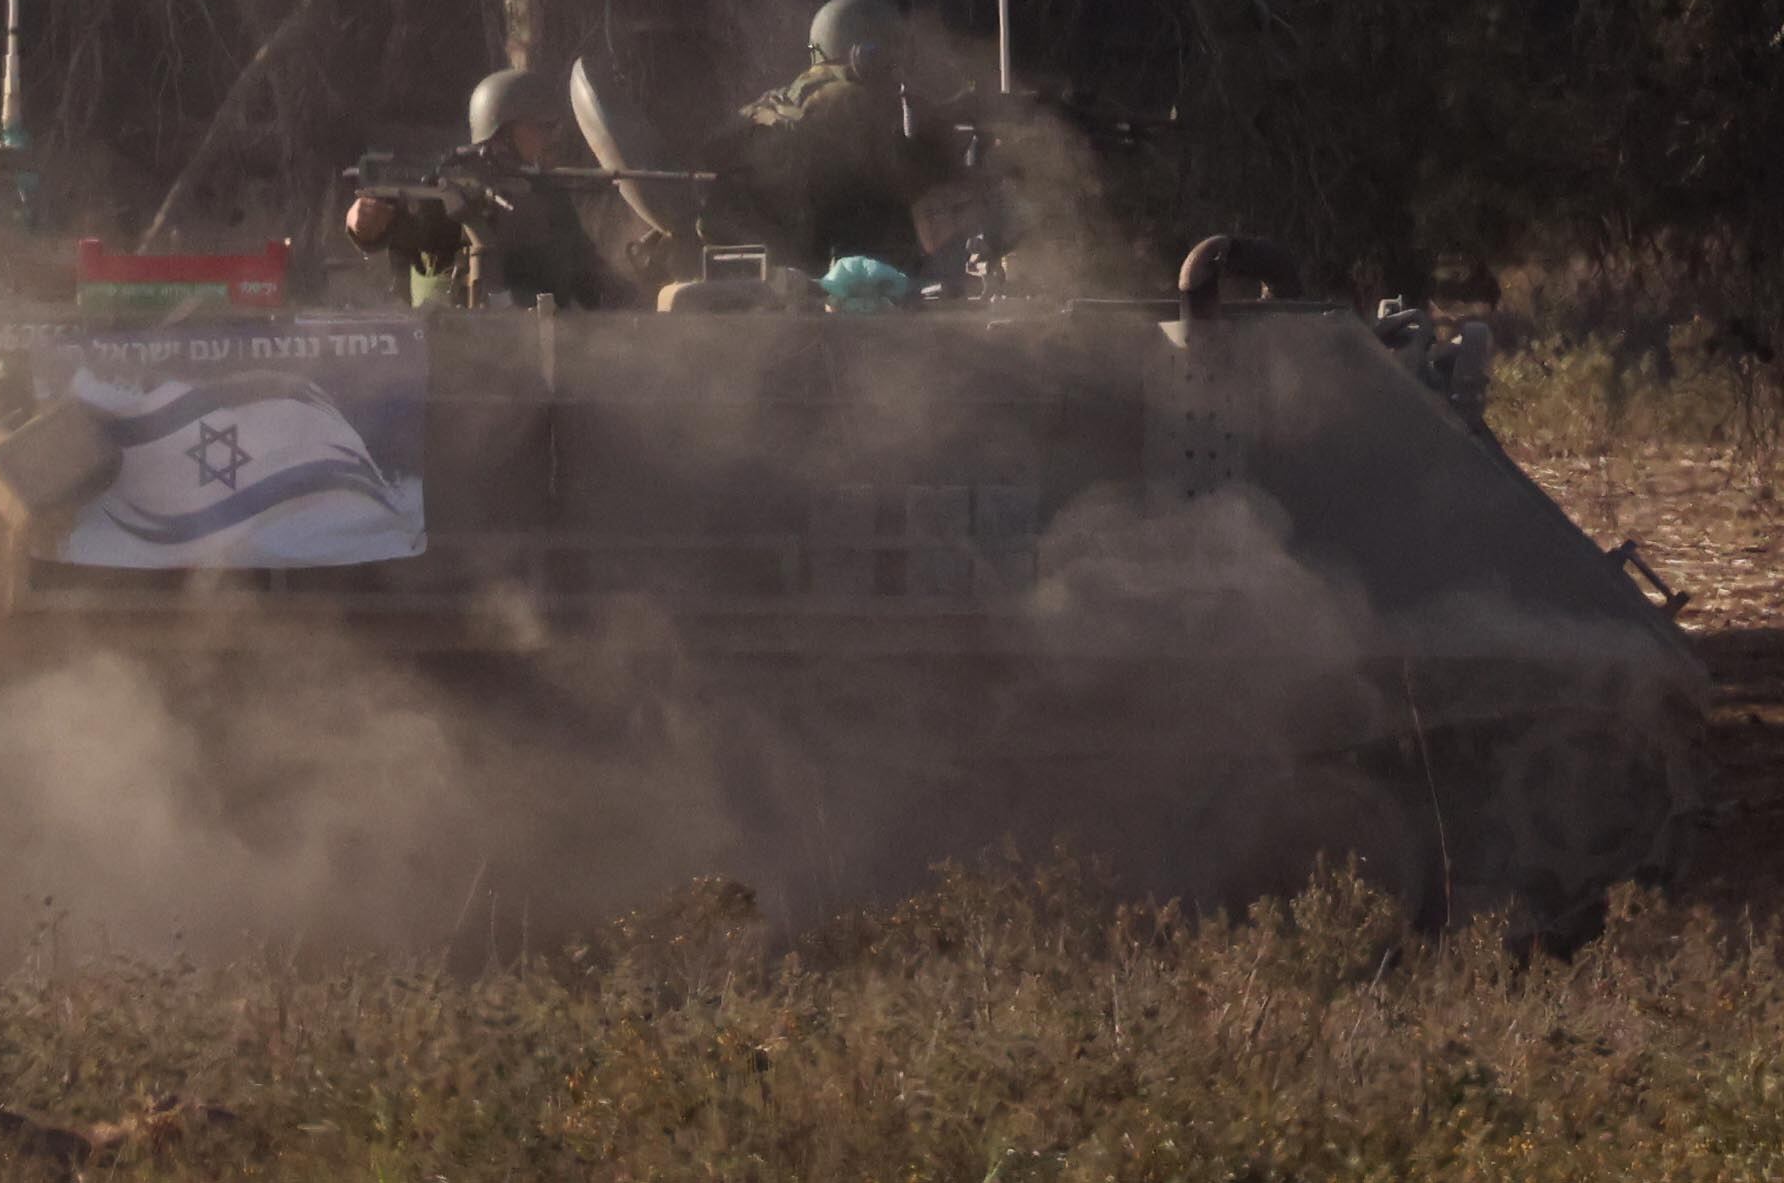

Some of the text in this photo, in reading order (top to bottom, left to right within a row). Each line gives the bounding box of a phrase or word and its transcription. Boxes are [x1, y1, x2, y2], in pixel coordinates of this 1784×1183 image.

[92, 337, 183, 362] ישראל
[190, 338, 231, 361] עם
[251, 336, 320, 359] ננצח
[327, 333, 399, 357] ביחד
